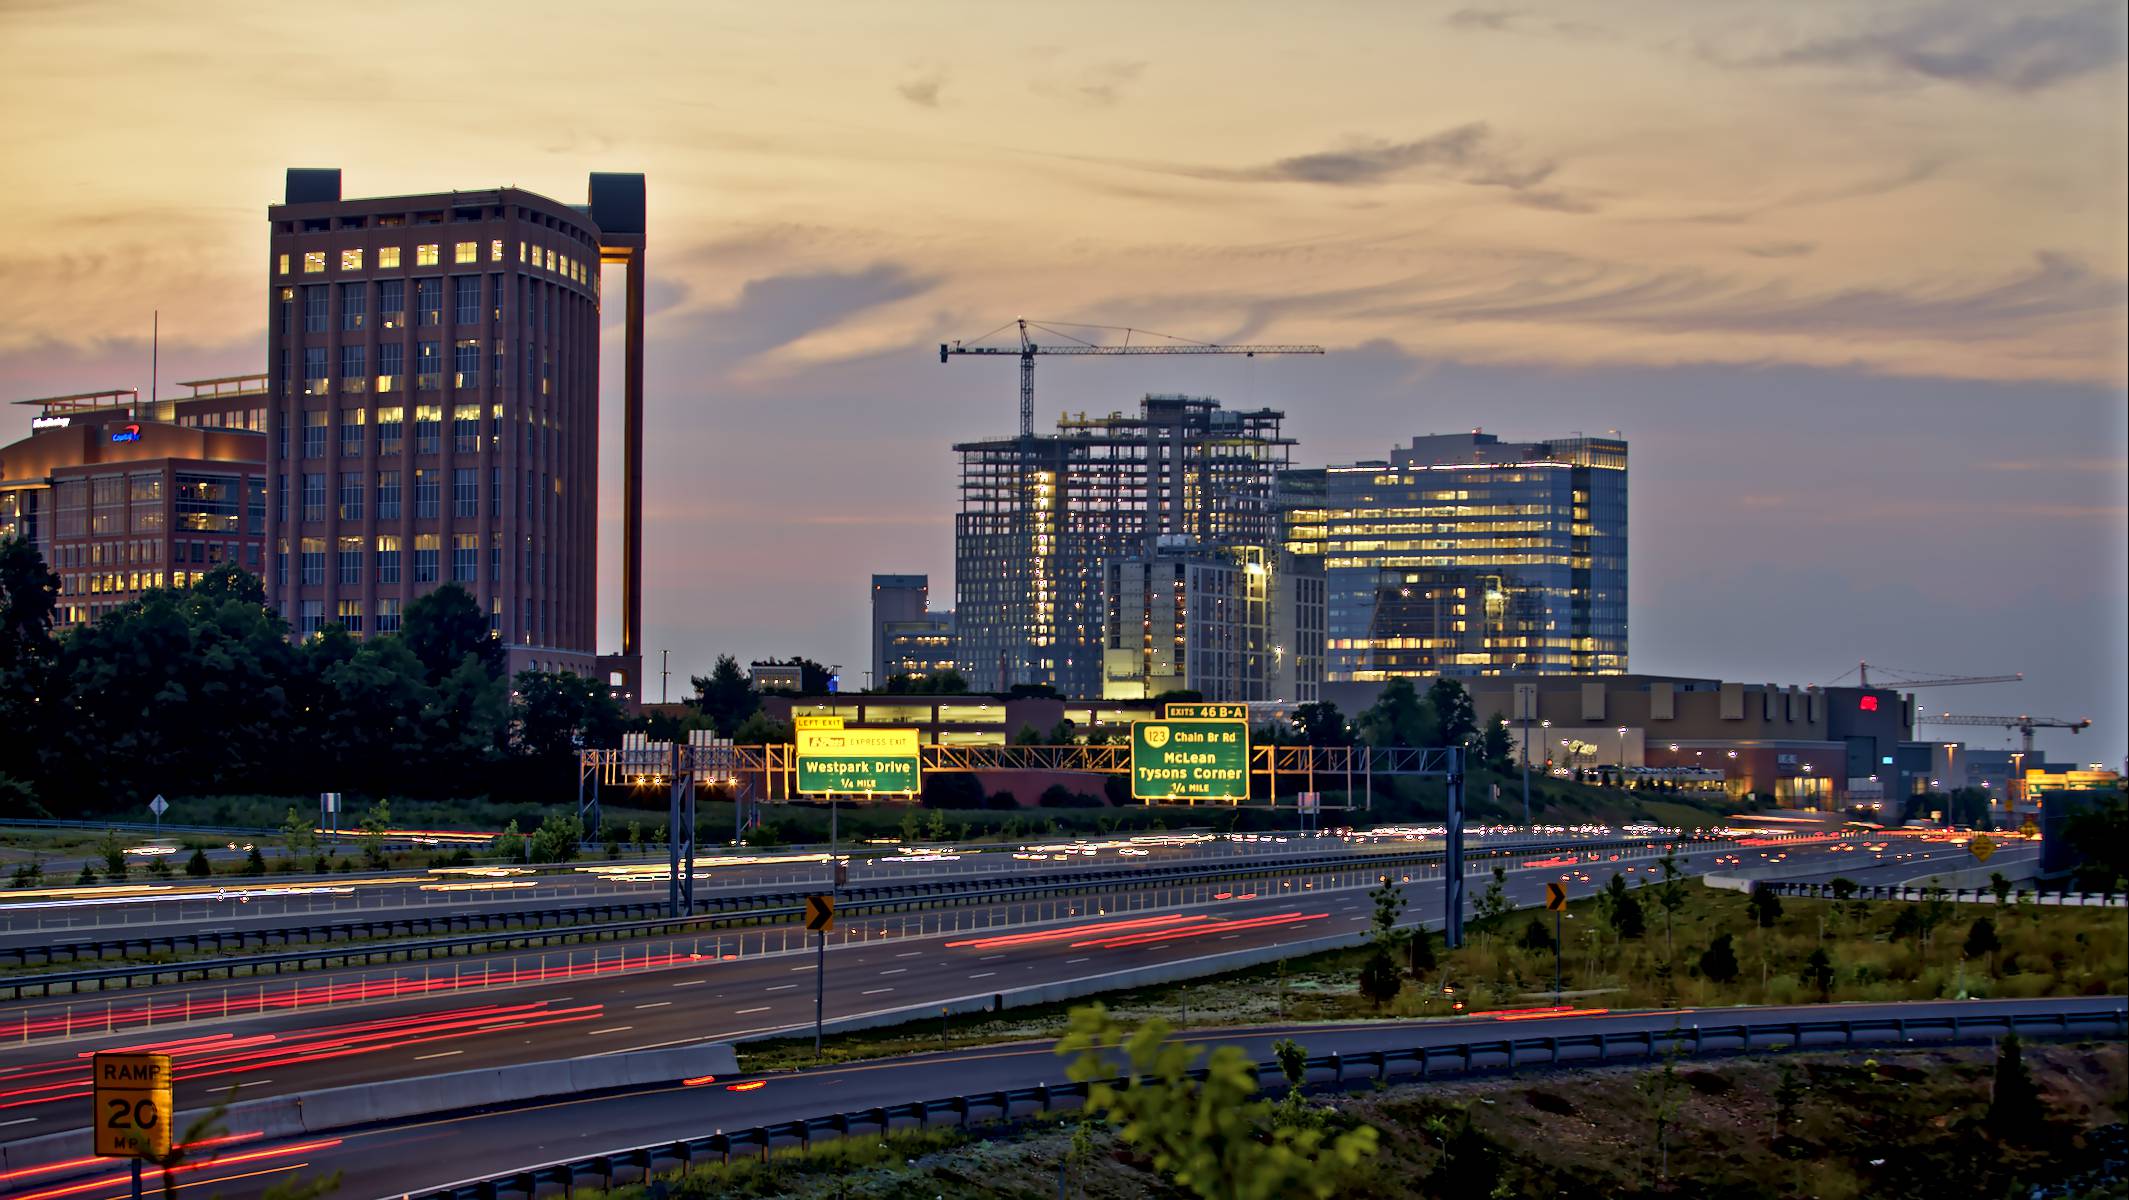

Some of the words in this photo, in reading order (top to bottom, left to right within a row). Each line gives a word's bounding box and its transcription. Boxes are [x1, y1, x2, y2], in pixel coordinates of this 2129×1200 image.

[1170, 708, 1194, 716] EXITS
[1200, 707, 1216, 717] 46
[1220, 707, 1242, 717] B-A
[850, 738, 887, 746] EXPRESS
[890, 738, 906, 746] EXIT
[1149, 731, 1166, 742] 123
[1174, 732, 1204, 742] Chain
[1207, 732, 1219, 742] Br
[1222, 732, 1236, 742] Rd
[1164, 752, 1216, 763] McLean
[806, 761, 869, 775] Westpark
[875, 761, 910, 773] Drive
[1139, 767, 1187, 781] Tysons
[1194, 767, 1242, 779] Corner
[857, 779, 876, 787] MILE
[1189, 784, 1209, 792] MILE
[104, 1064, 160, 1080] RAMP
[107, 1098, 158, 1129] 20
